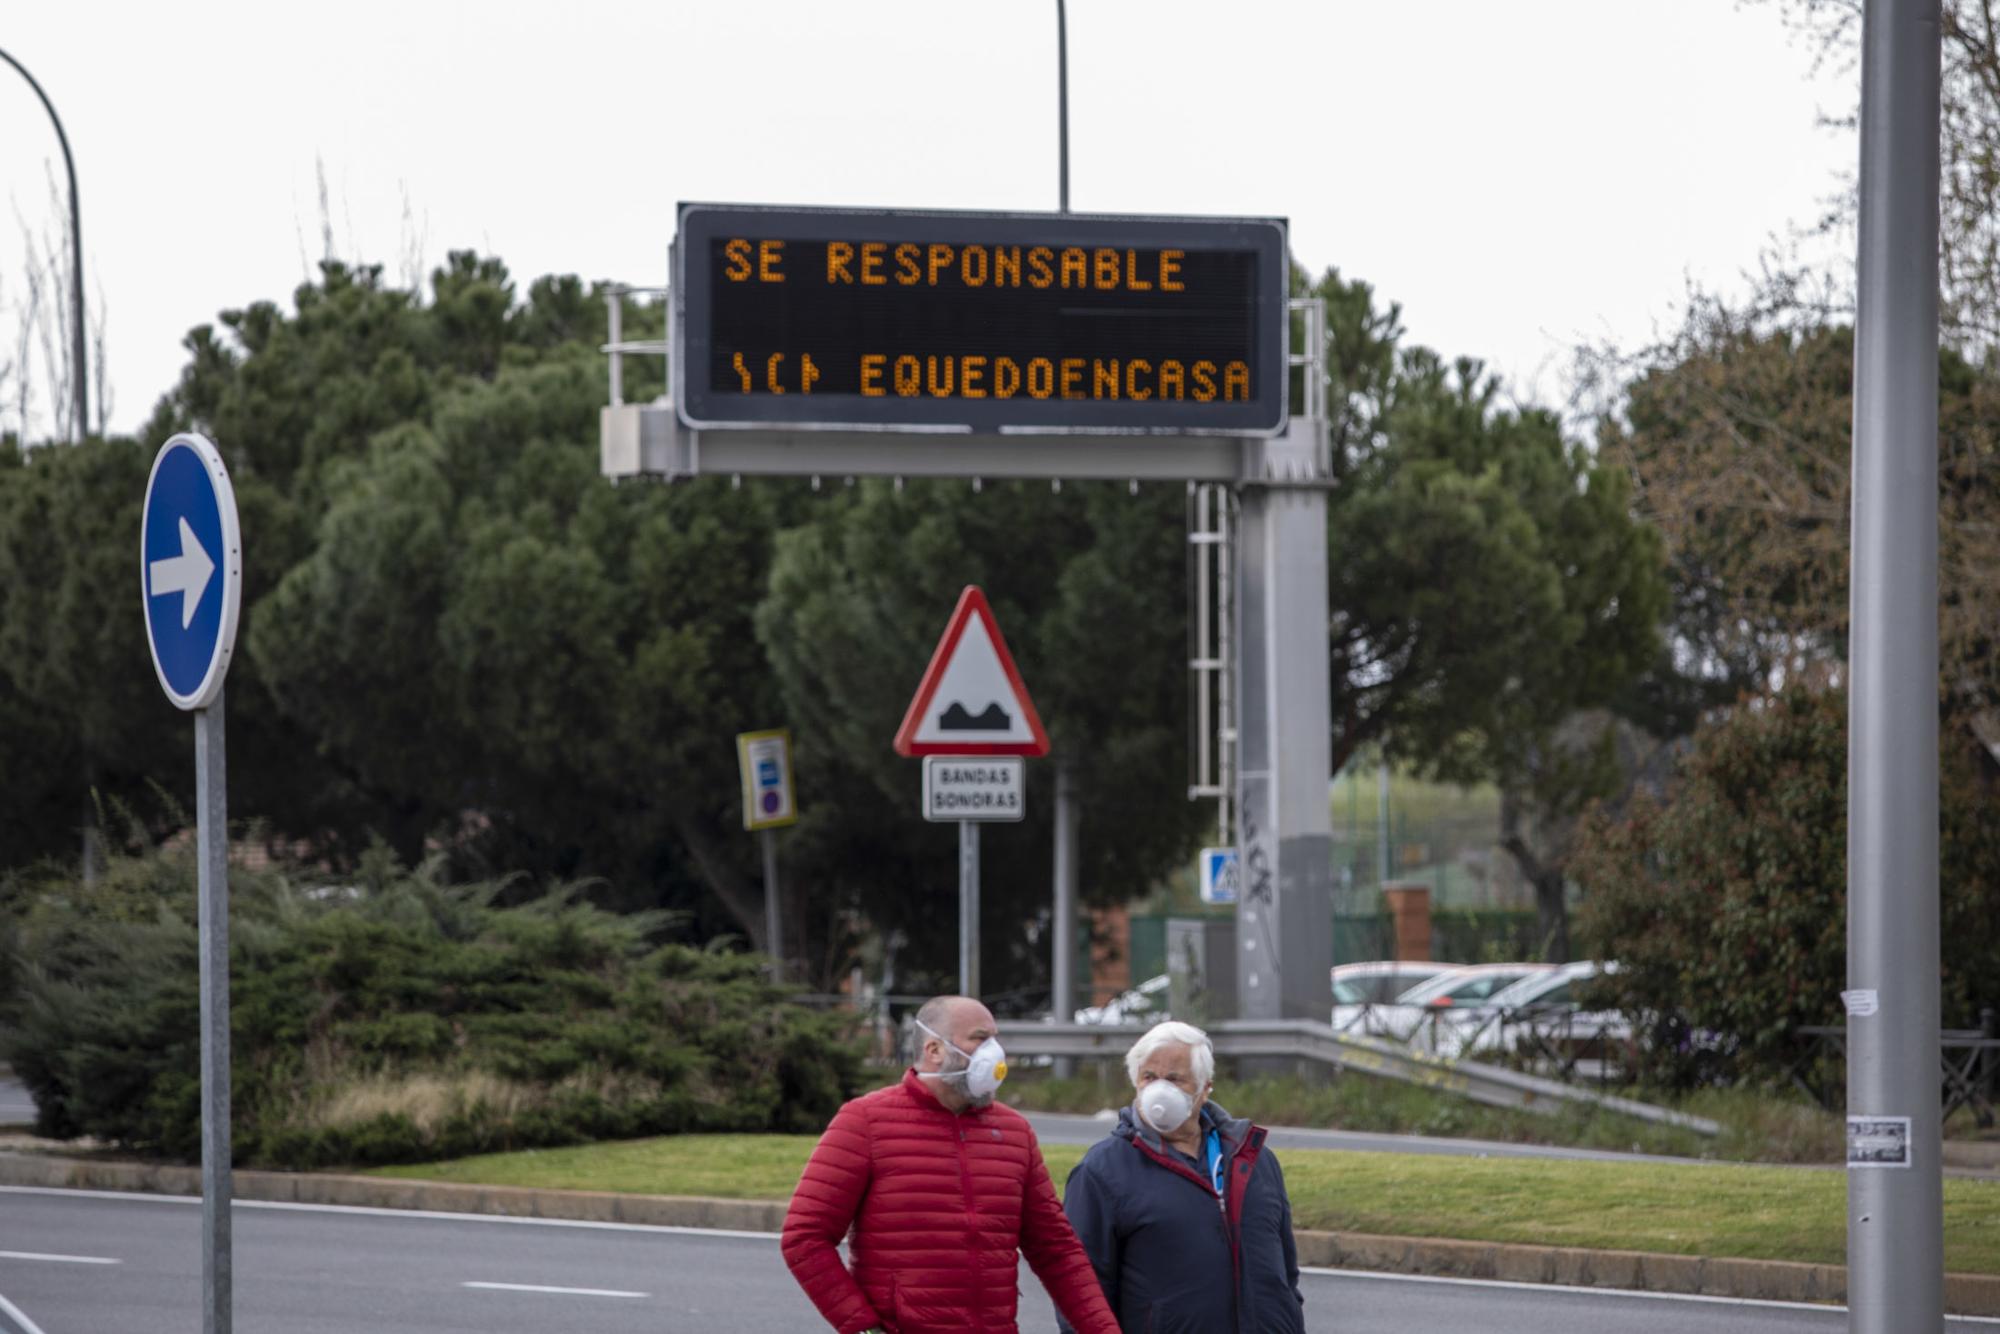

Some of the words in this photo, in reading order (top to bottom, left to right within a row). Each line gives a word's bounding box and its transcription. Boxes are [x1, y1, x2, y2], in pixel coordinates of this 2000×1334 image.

[725, 239, 785, 282] SE
[827, 241, 1185, 291] RESPONSABLE
[860, 354, 1249, 401] EQUEDOENCASA
[940, 767, 1011, 785] BANDAS
[935, 791, 1019, 809] SONORAS
